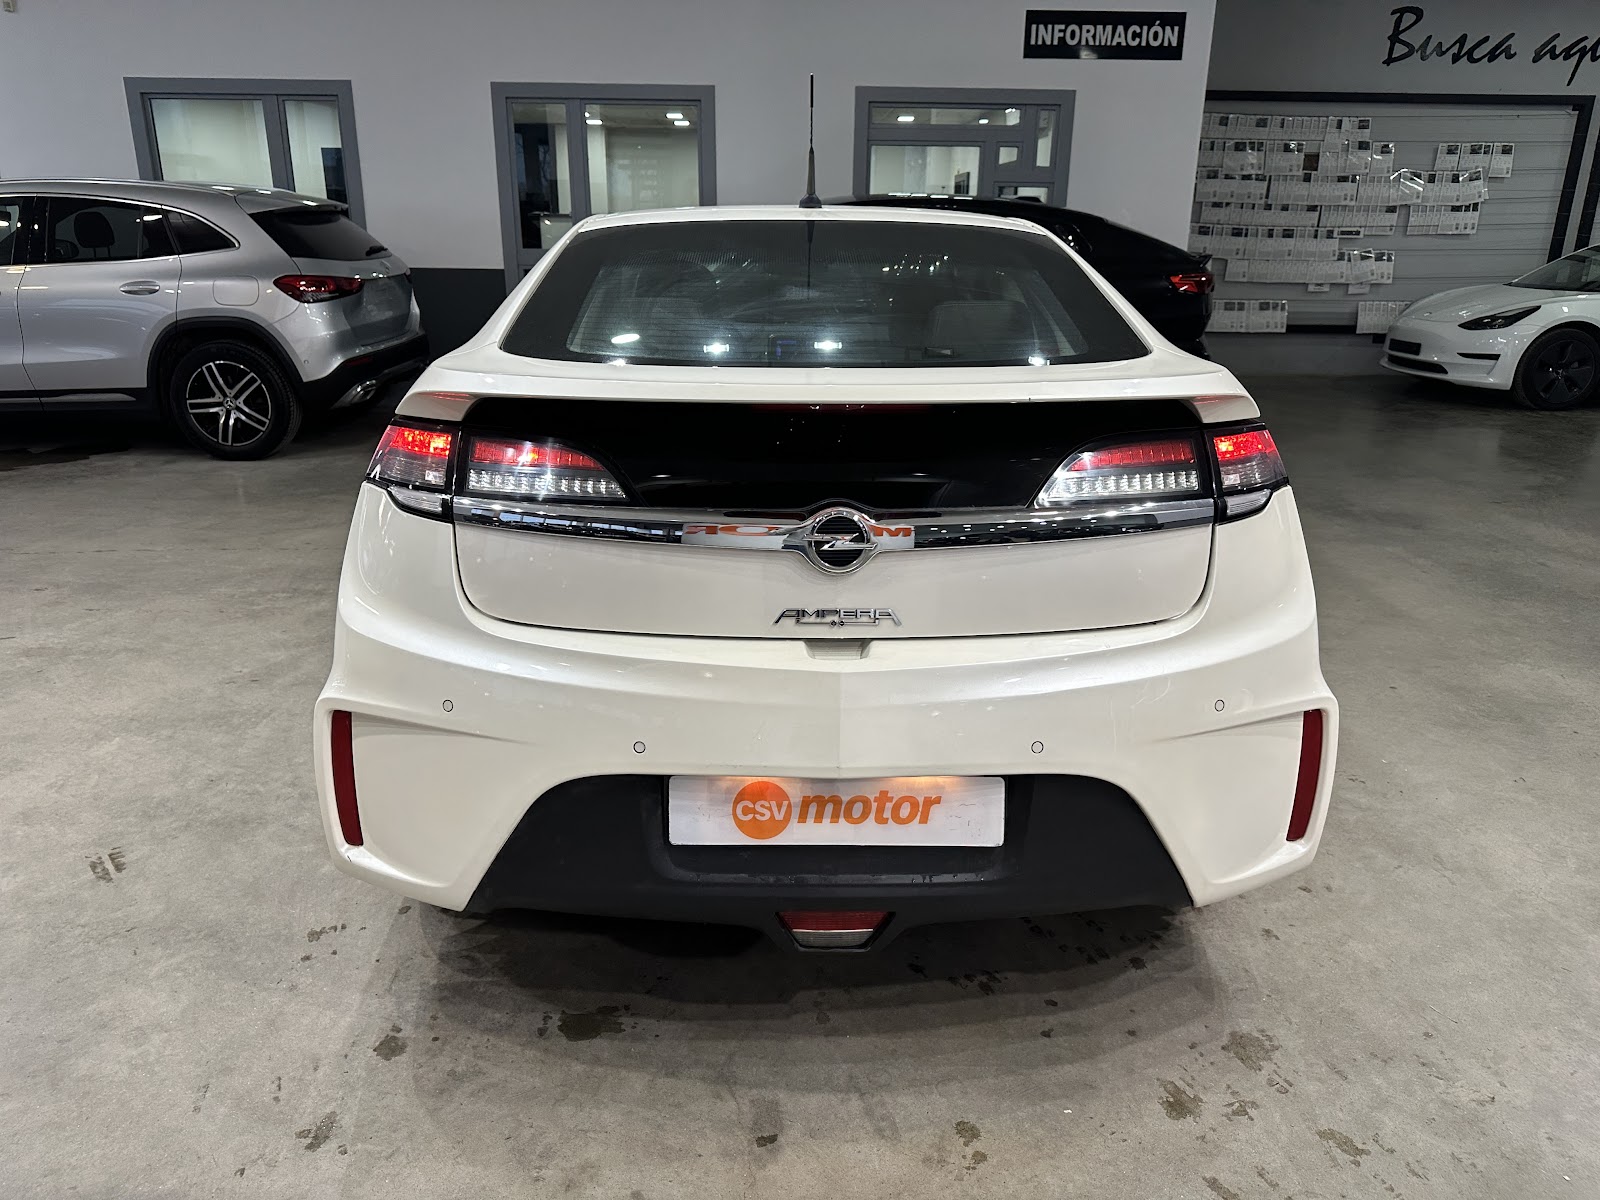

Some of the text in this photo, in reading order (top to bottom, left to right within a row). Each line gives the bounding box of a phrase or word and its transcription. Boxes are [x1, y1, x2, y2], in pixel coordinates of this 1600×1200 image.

[1029, 20, 1180, 47] INFORMACIÓN
[1382, 5, 1517, 66] Busca
[772, 607, 902, 626] AMPERA
[735, 790, 942, 825] CSV motor
